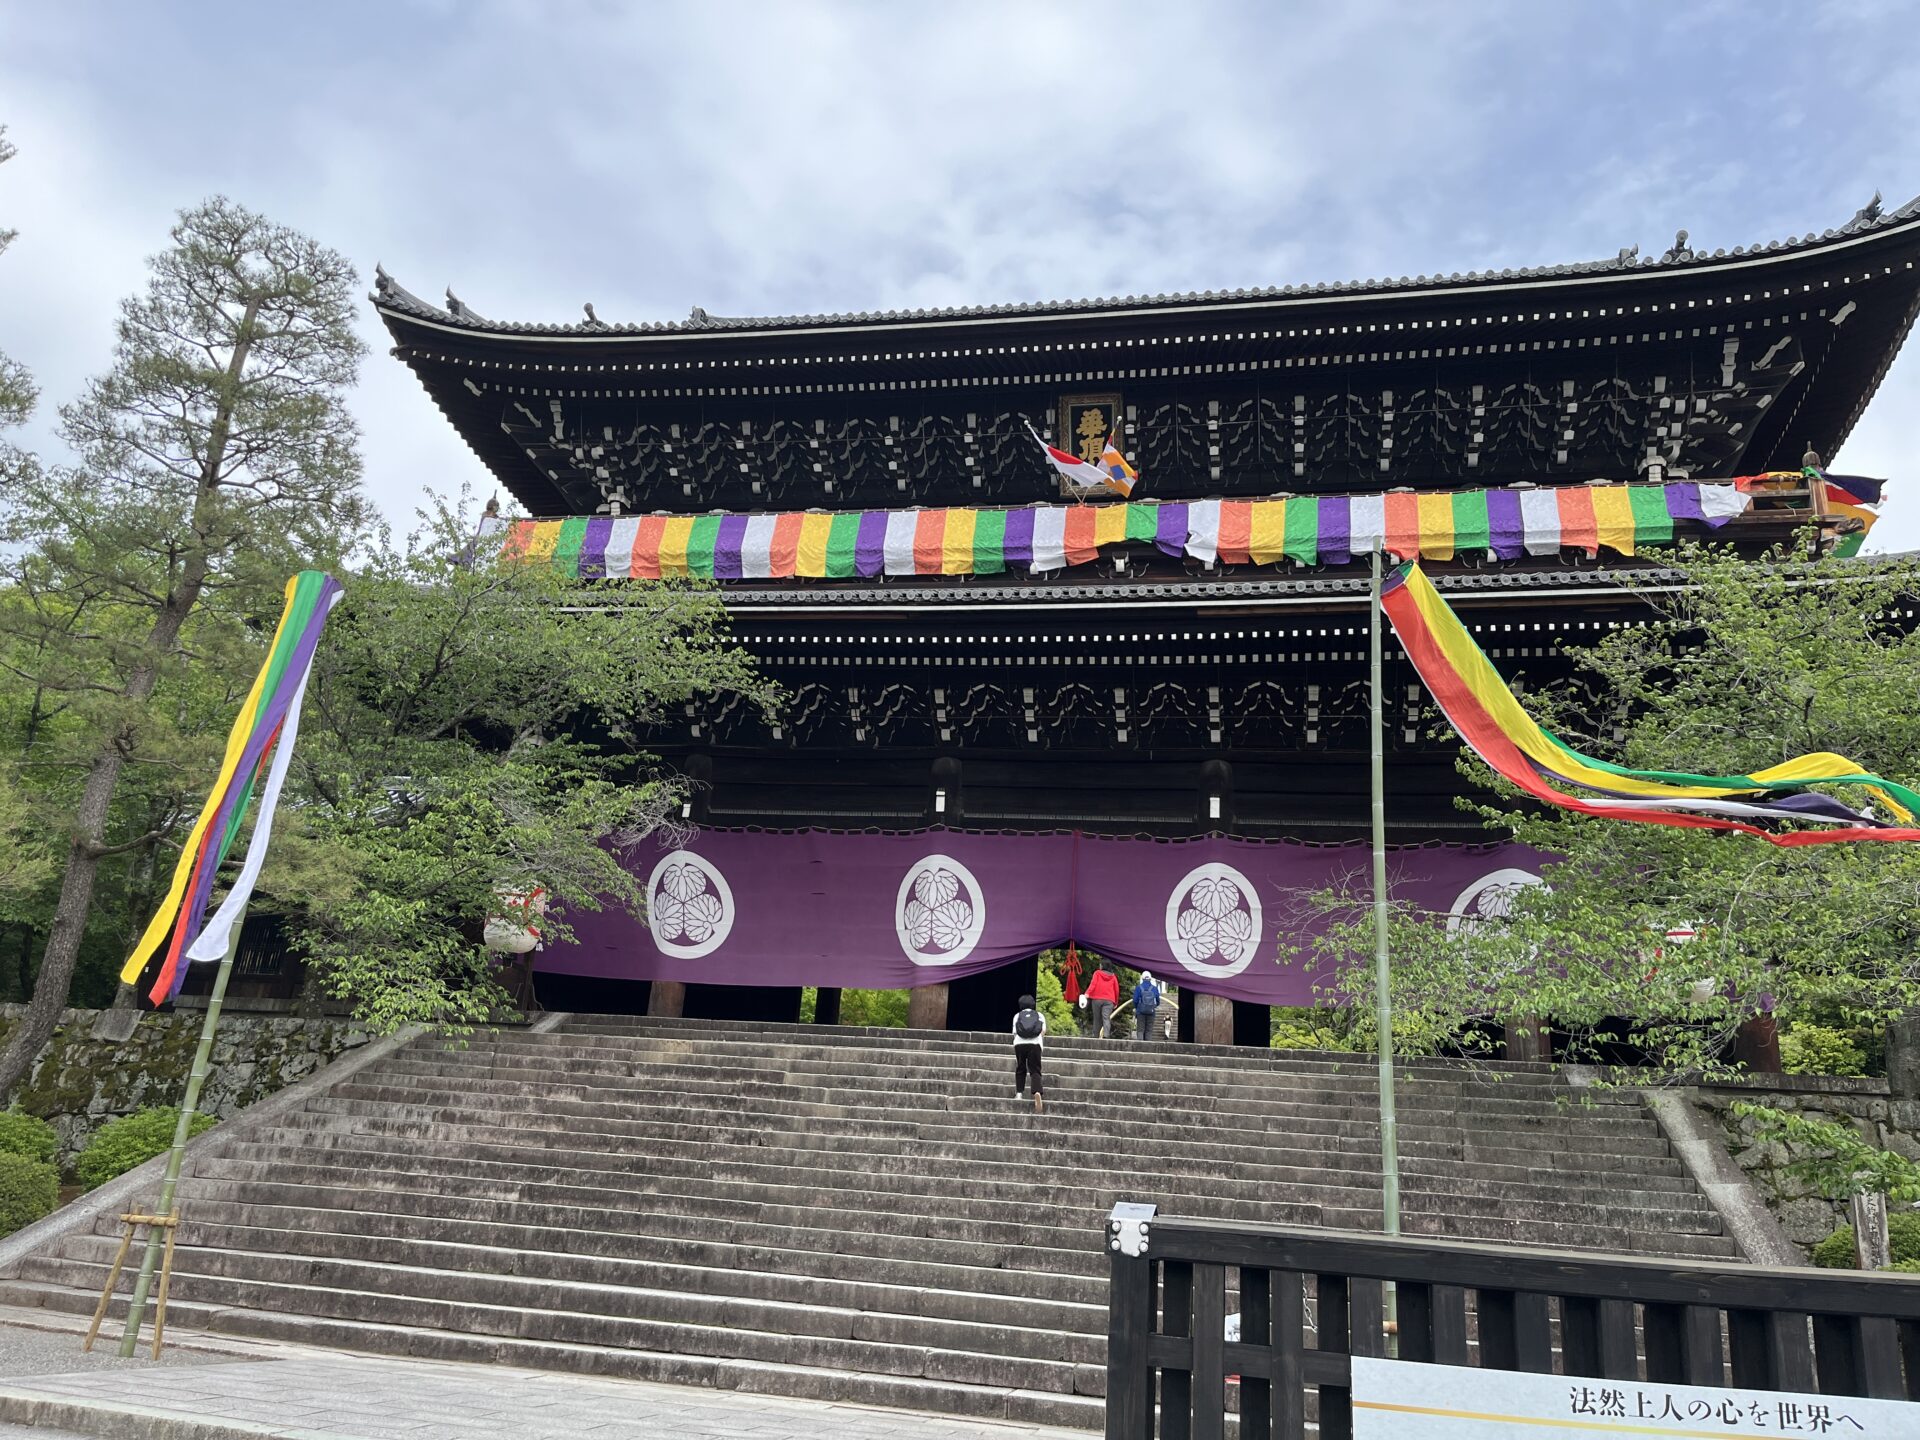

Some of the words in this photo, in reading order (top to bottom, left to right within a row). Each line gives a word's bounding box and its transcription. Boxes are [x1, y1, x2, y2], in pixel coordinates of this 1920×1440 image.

[1076, 408, 1107, 465] 華頂
[1570, 1386, 1864, 1433] 法然上人の心を世界へ
